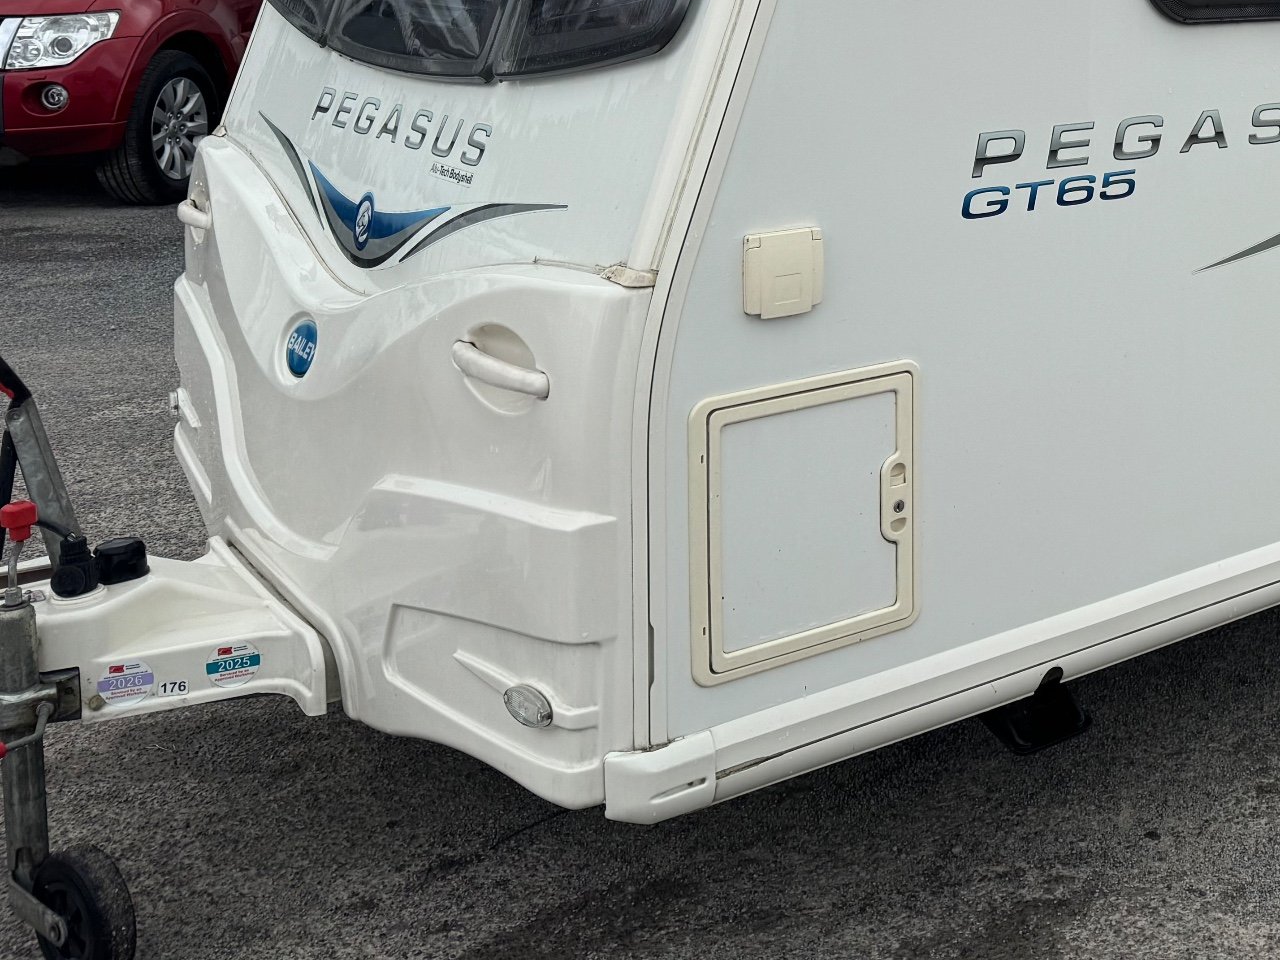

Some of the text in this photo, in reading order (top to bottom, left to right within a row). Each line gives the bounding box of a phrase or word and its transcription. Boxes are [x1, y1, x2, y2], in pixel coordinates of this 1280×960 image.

[311, 86, 493, 167] PEGASUS
[961, 168, 1137, 220] GT65
[288, 331, 316, 362] BAILEY
[217, 656, 251, 672] 2025
[109, 675, 144, 691] 2026
[160, 681, 187, 694] 176
